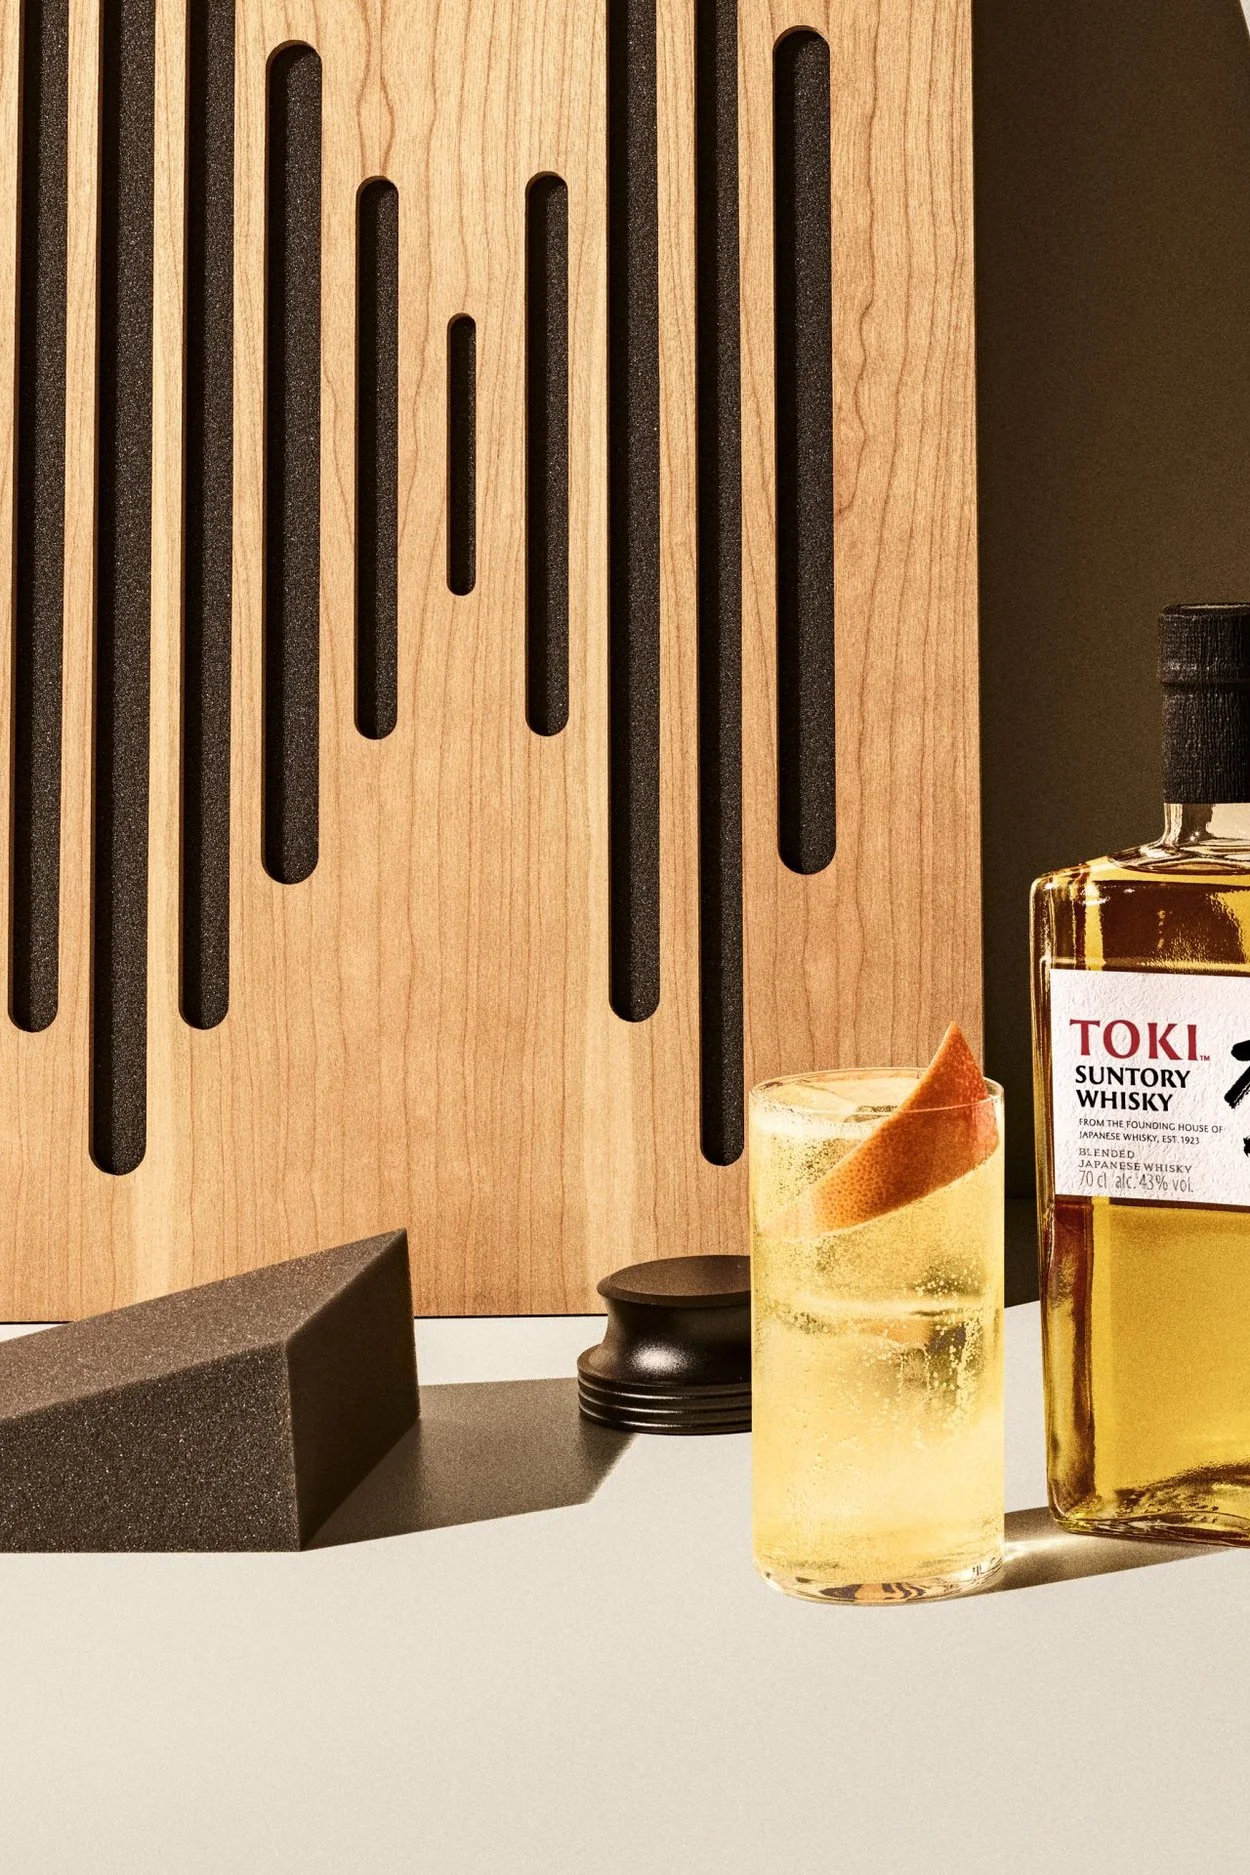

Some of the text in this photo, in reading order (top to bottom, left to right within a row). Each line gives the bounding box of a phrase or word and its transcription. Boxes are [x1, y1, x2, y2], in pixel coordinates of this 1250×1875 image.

[1075, 1065, 1191, 1089] SUNTORY
[1076, 1089, 1174, 1112] WHISKY
[1079, 1118, 1223, 1134] FROM THE FOUNDING HOUSE OF
[1079, 1131, 1200, 1145] JAPANESE WHISKY, EST. 1923
[1078, 1147, 1135, 1159] BLENDED
[1078, 1159, 1192, 1174] JAPANESE WHISKY
[1079, 1170, 1194, 1193] 70 cl alc. 43% vol.
